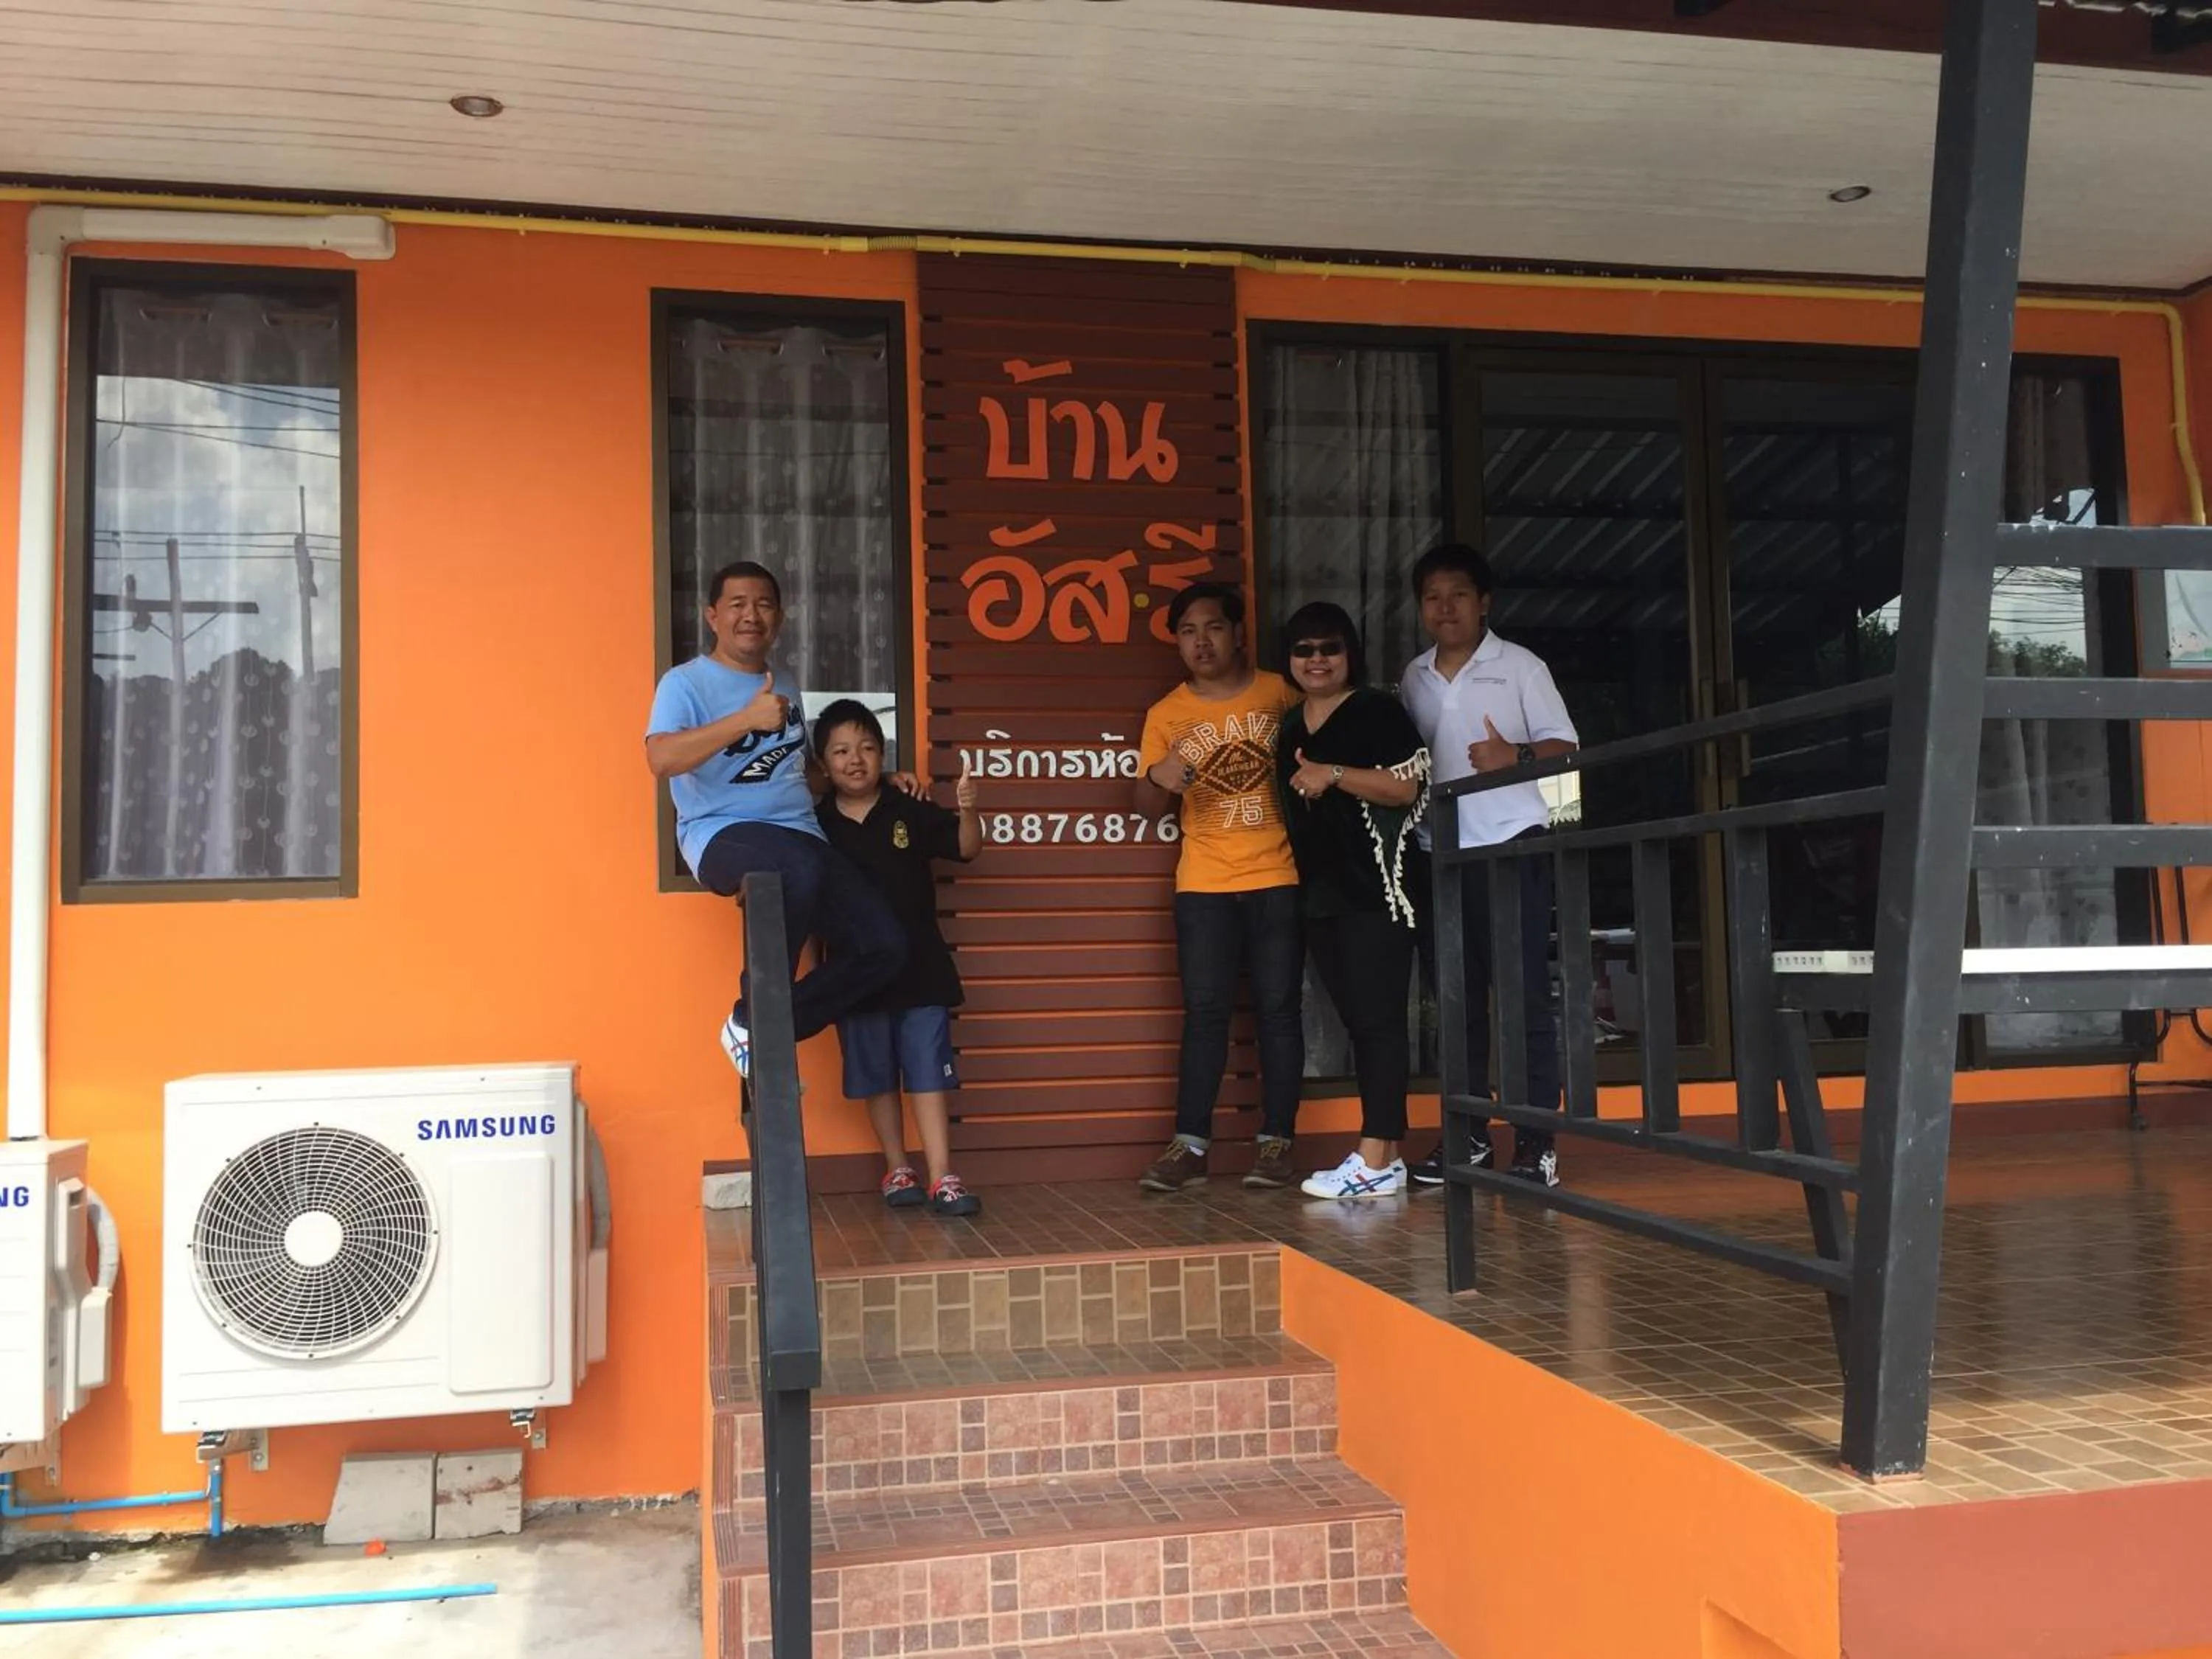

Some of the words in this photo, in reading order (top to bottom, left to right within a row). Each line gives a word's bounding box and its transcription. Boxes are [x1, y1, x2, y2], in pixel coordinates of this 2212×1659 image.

[979, 359, 1179, 483] บ้าน
[1219, 796, 1263, 828] 75
[417, 1114, 556, 1141] SAMSUNG
